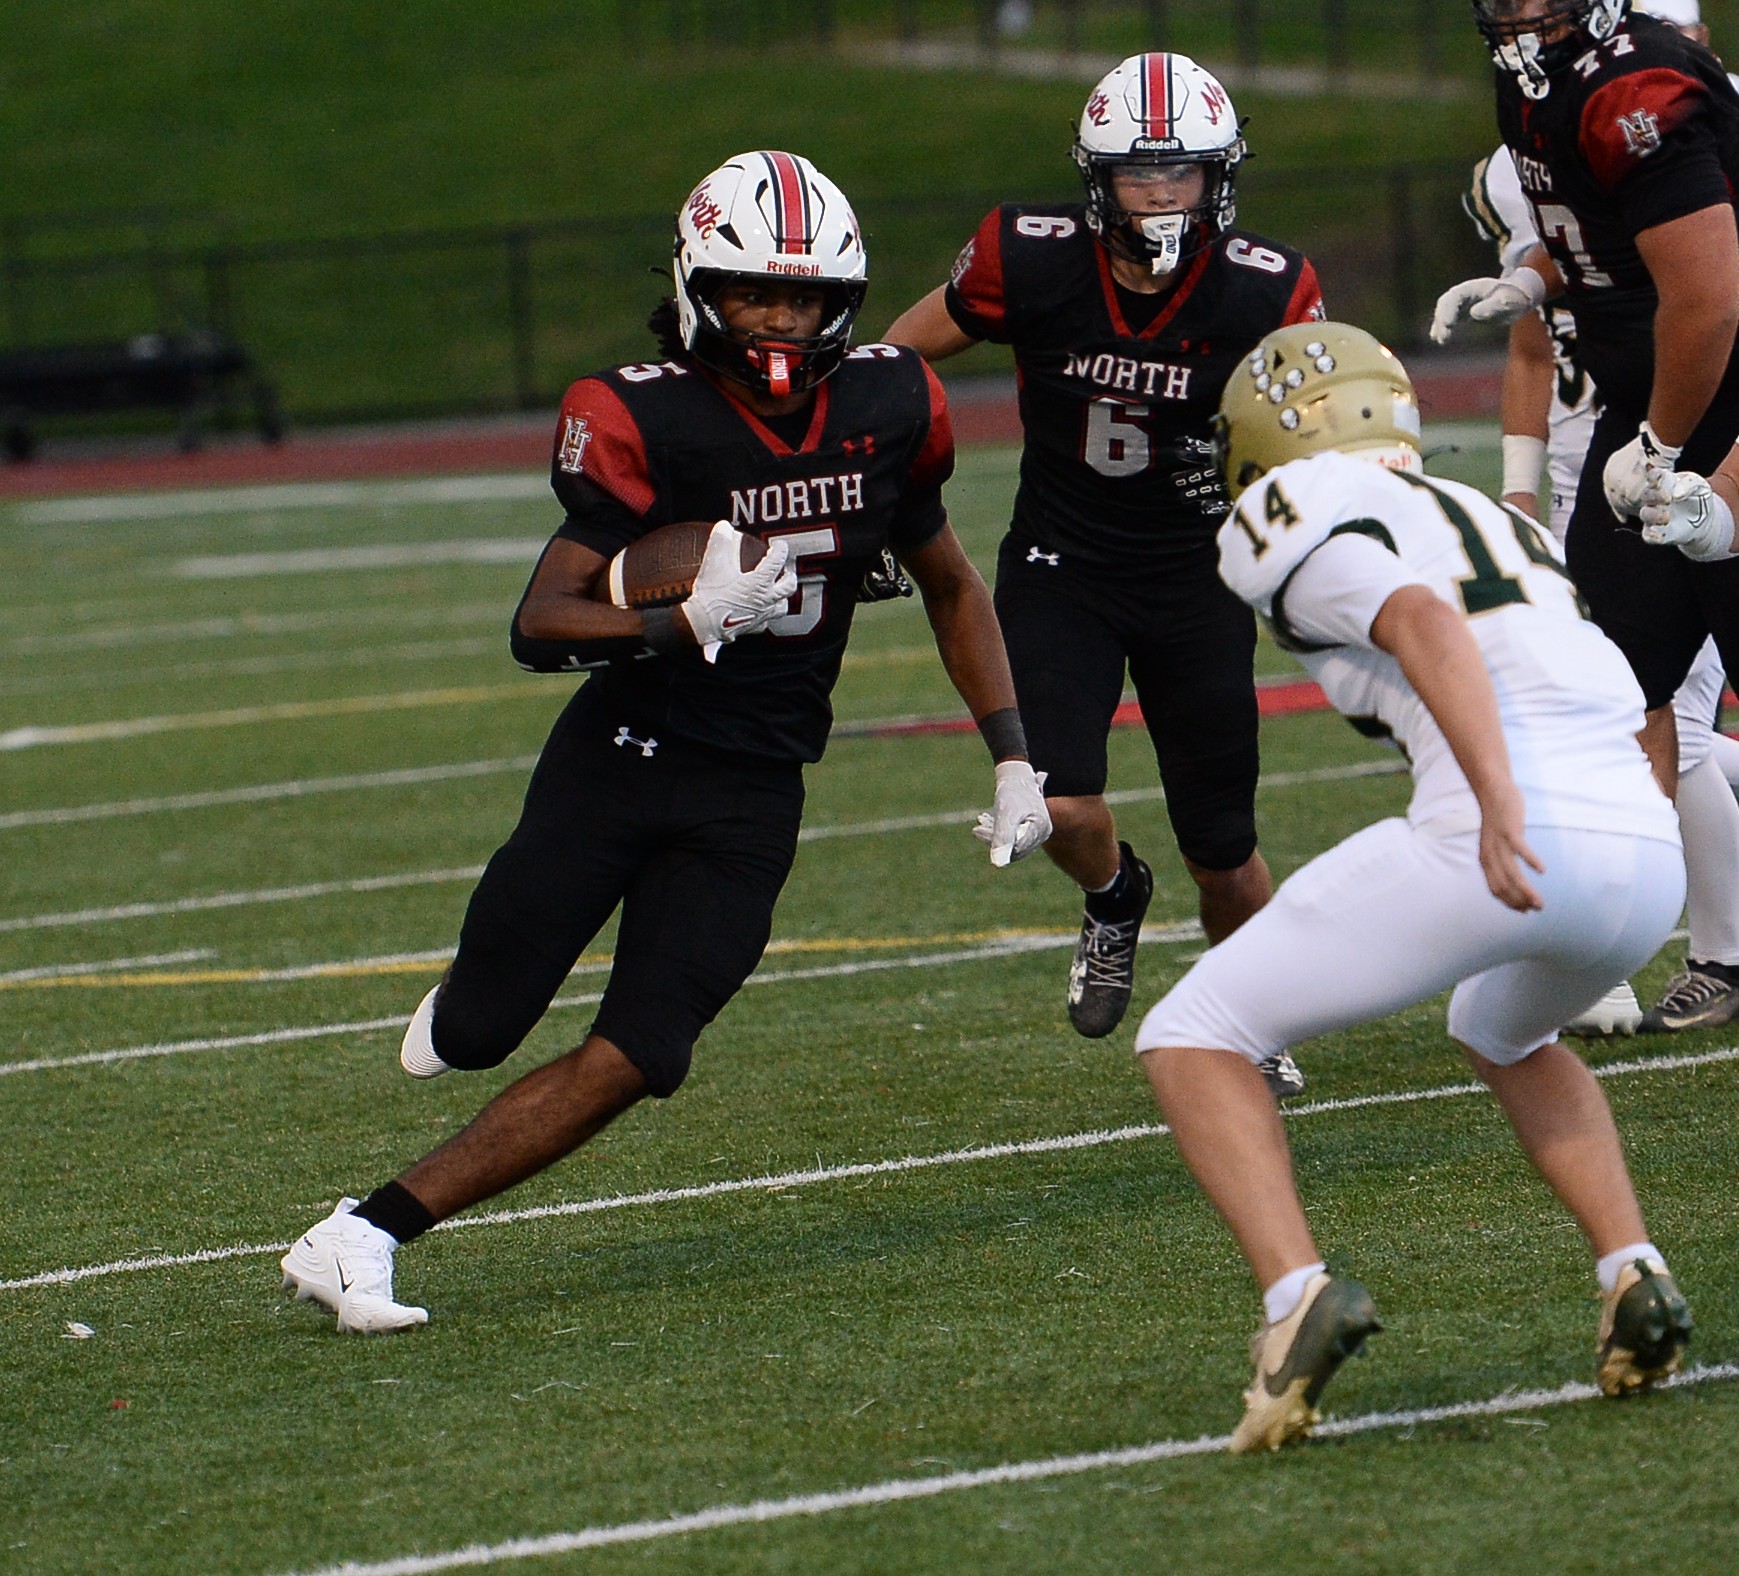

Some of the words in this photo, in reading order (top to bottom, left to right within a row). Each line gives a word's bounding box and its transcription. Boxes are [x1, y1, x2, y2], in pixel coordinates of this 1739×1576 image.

[1135, 139, 1180, 150] Riddell
[1016, 215, 1076, 239] 6
[767, 260, 820, 276] Riddell
[1225, 237, 1288, 274] 6
[842, 343, 900, 361] 5
[618, 361, 688, 383] 5
[1063, 352, 1192, 400] NORTH
[1084, 396, 1151, 478] 6
[730, 473, 864, 526] NORTH
[1234, 479, 1300, 561] 14
[763, 523, 840, 640] 5
